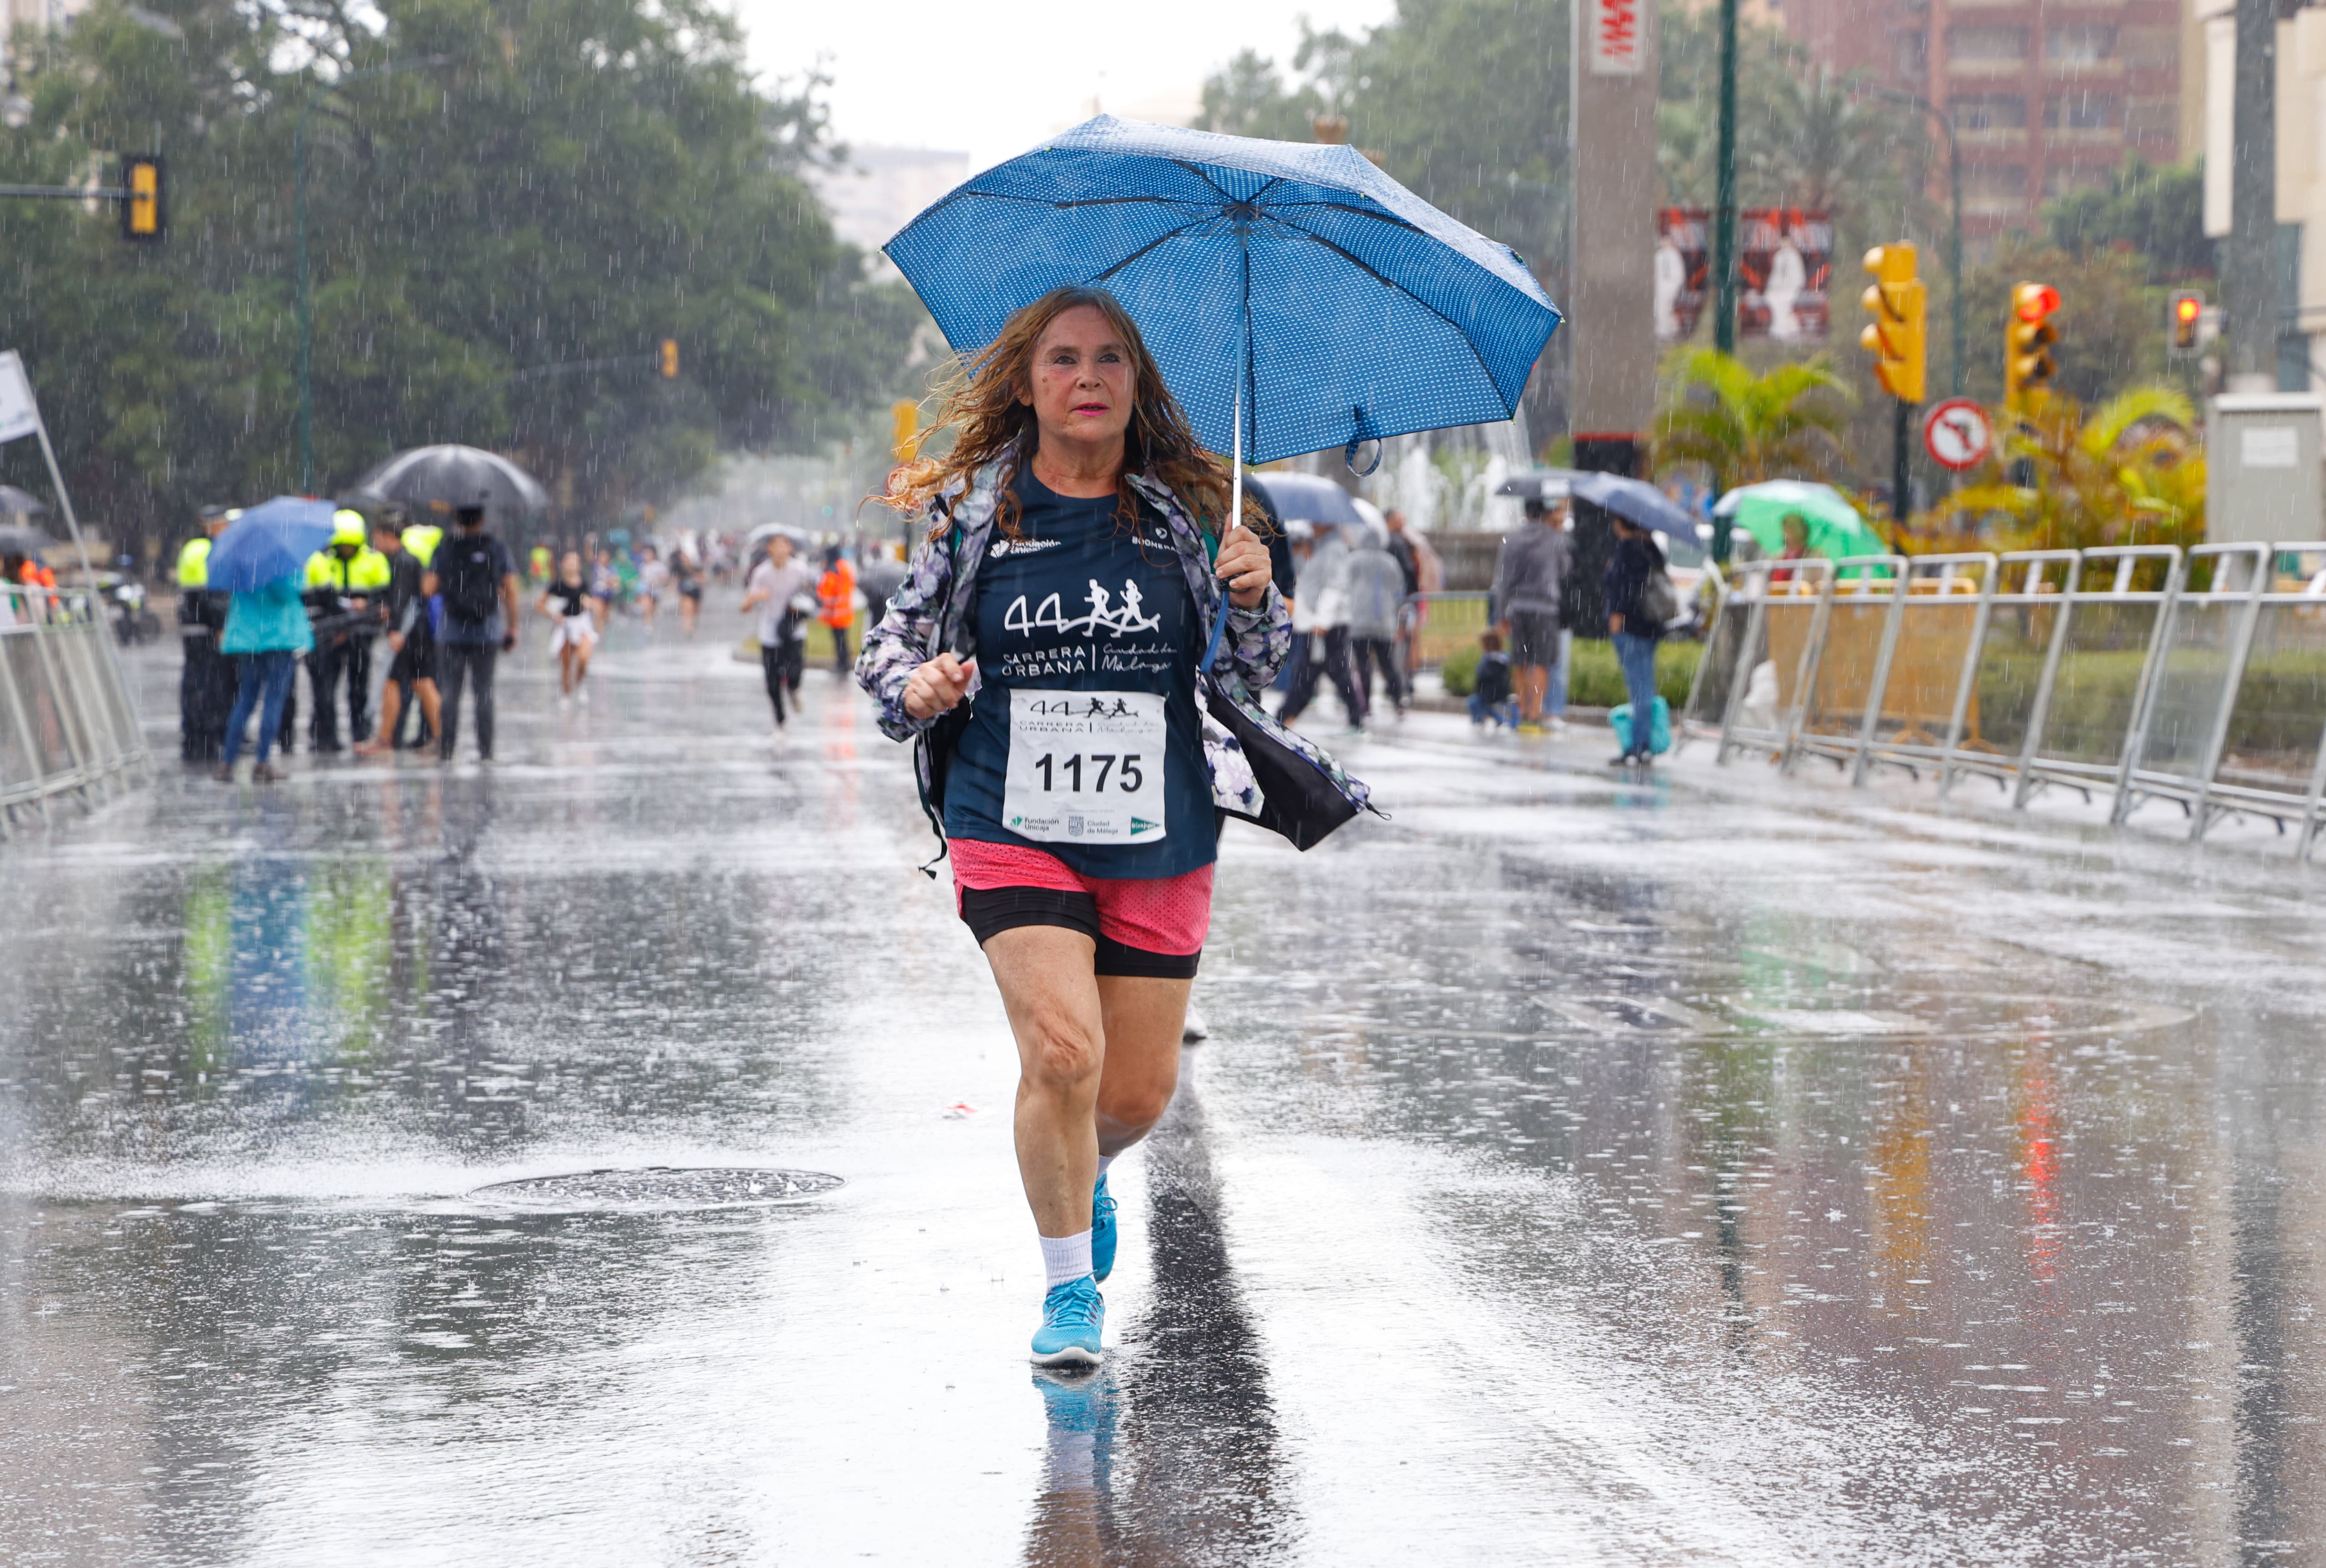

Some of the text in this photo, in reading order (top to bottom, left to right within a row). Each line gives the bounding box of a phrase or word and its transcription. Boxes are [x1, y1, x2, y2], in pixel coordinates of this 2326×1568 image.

[1004, 592, 1069, 638] 44
[1003, 645, 1086, 665] CARRERA
[1002, 660, 1086, 677] URBANA
[1030, 700, 1074, 716] 44
[1035, 753, 1143, 793] 1175
[1024, 817, 1059, 825] Fundación
[1024, 821, 1049, 832] Unicaja
